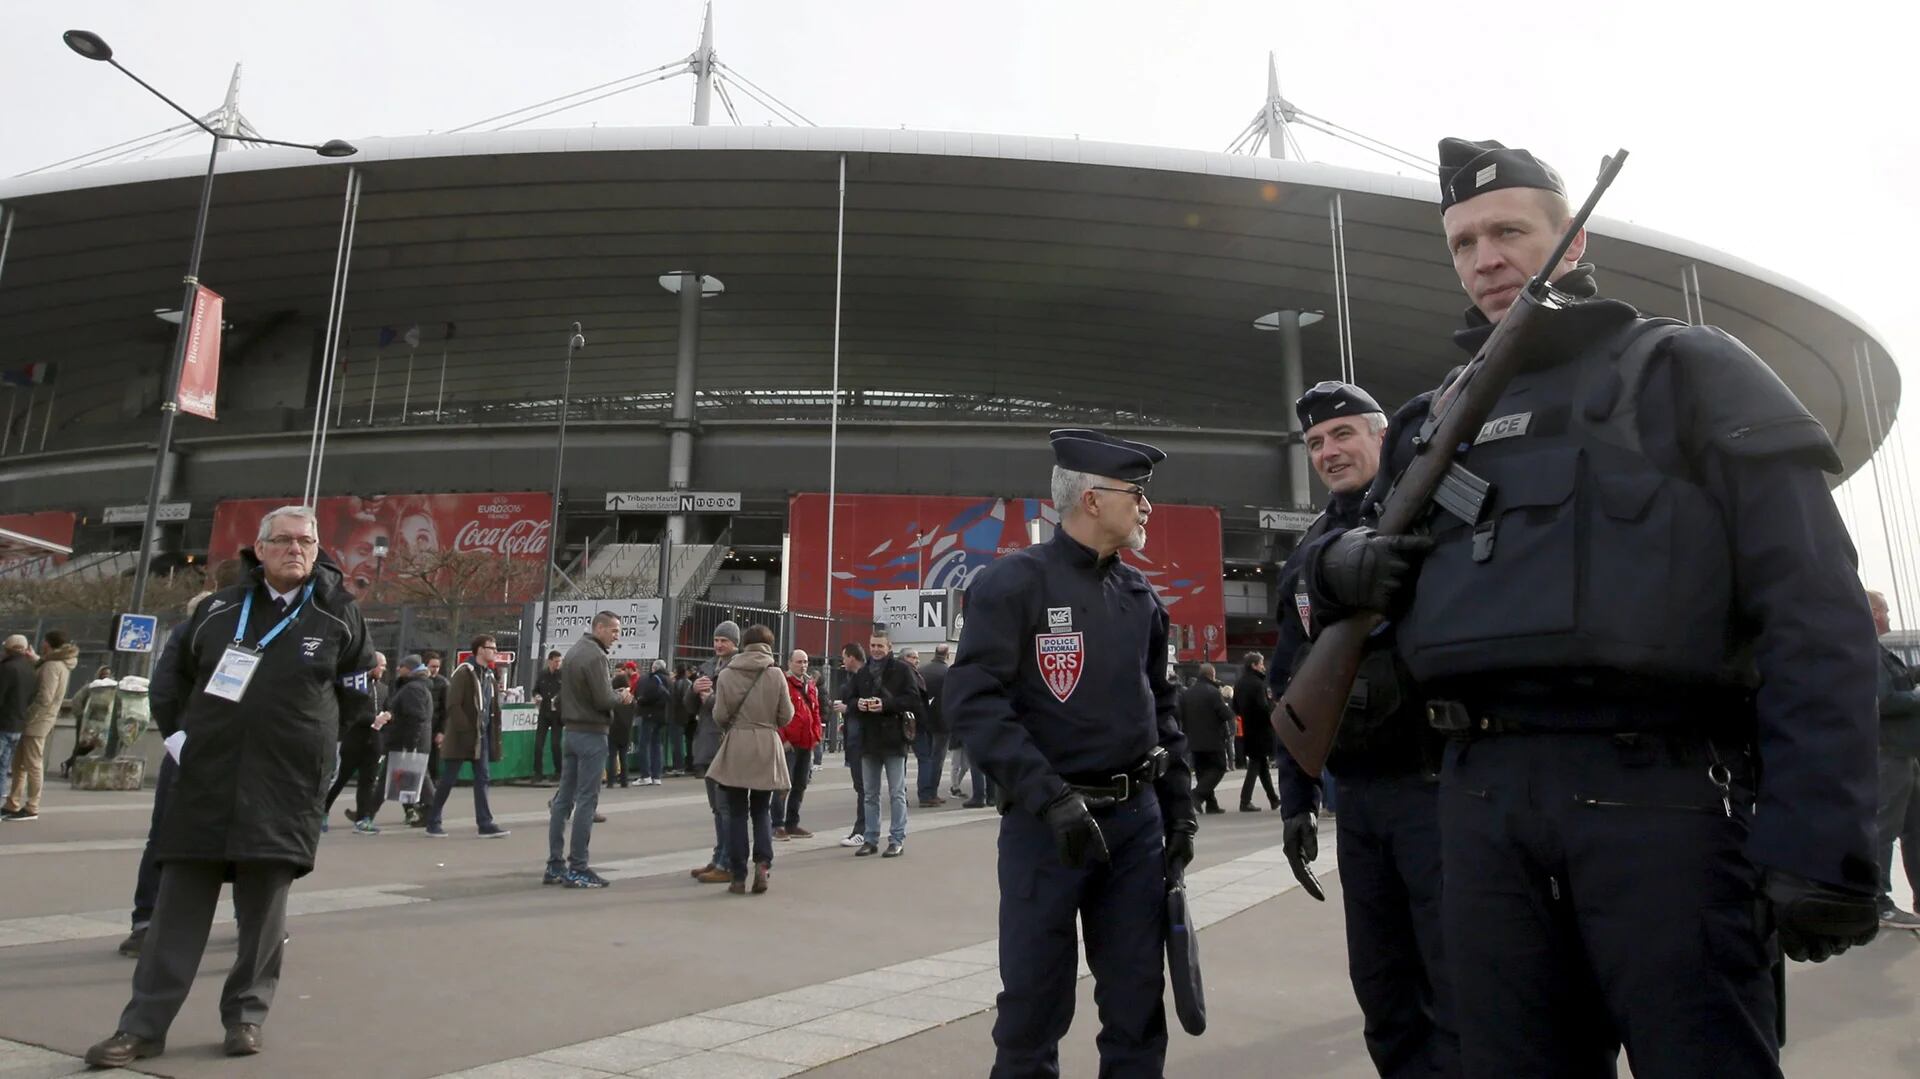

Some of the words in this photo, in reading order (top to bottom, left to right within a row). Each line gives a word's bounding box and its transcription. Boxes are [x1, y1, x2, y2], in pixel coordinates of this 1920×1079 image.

[188, 299, 205, 364] Bienvenue
[1481, 418, 1522, 437] LICE
[656, 494, 678, 502] Haute
[681, 497, 693, 511] N
[454, 519, 551, 554] Coca-Cola
[923, 601, 943, 628] N
[1041, 644, 1078, 653] NATIONALE
[1044, 638, 1075, 646] POLICE
[1043, 653, 1078, 670] CRS
